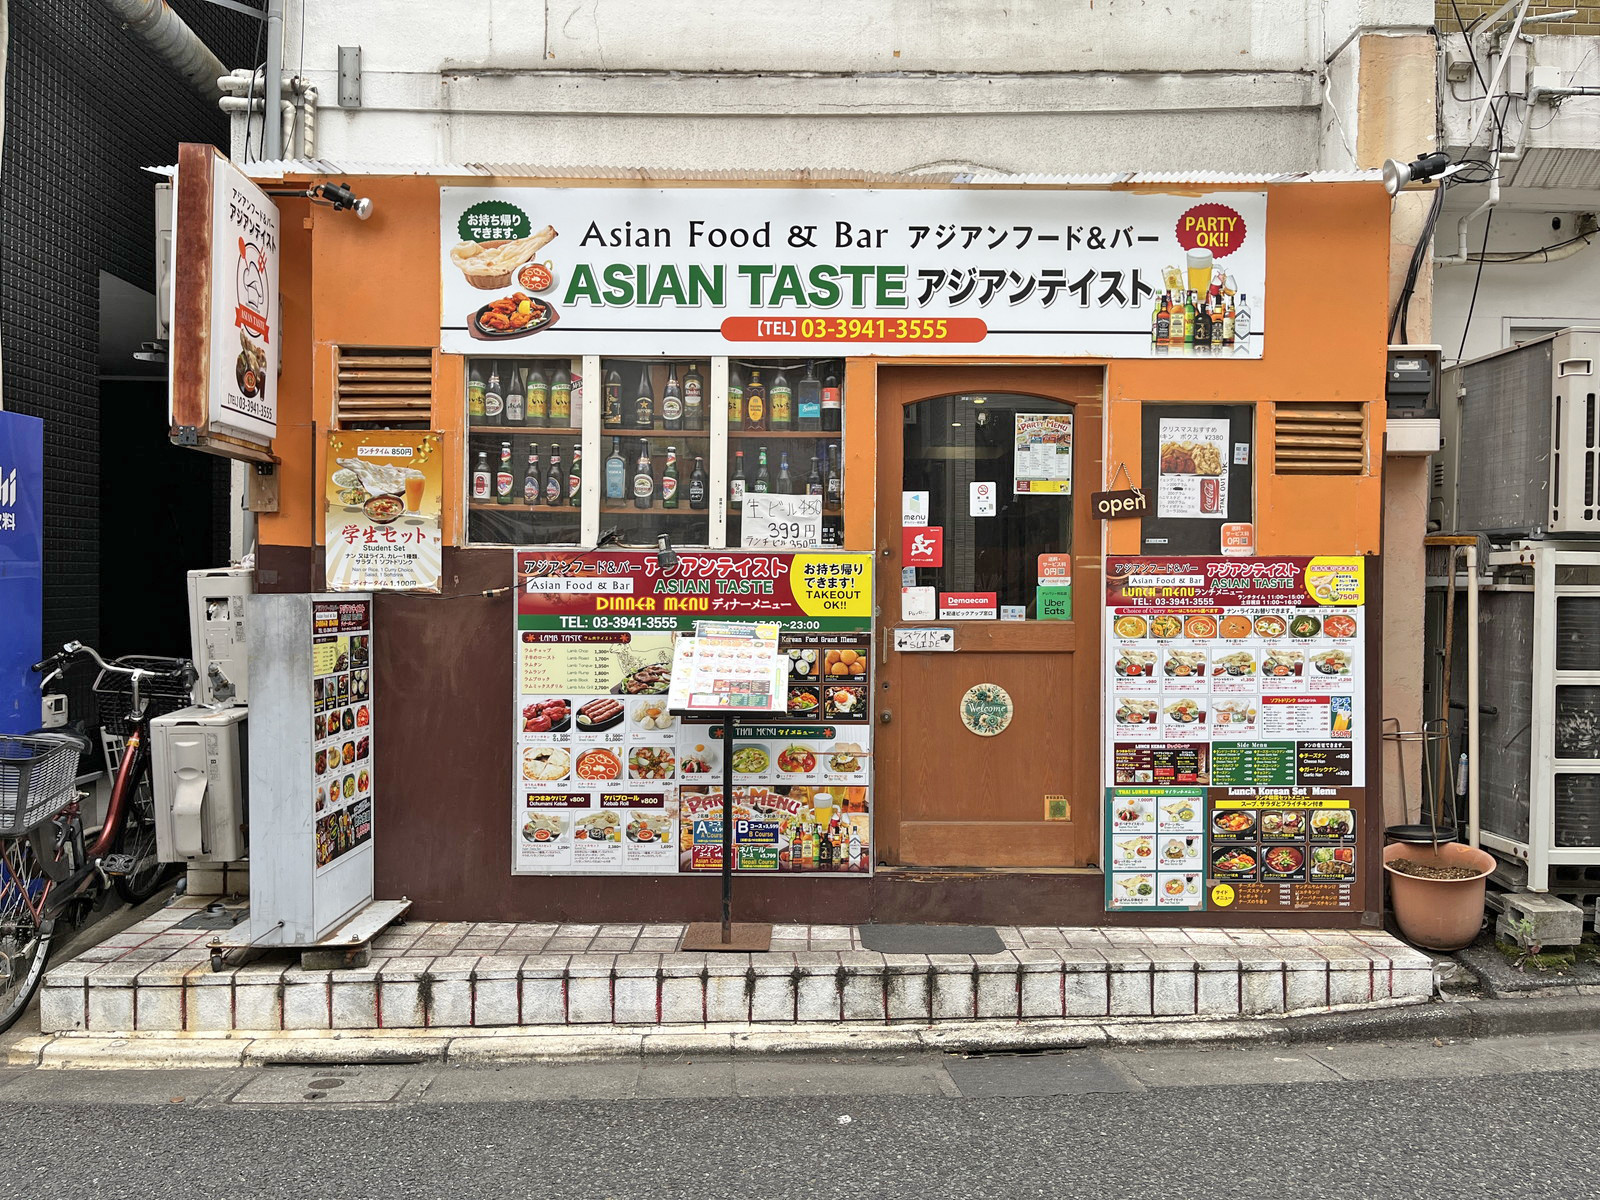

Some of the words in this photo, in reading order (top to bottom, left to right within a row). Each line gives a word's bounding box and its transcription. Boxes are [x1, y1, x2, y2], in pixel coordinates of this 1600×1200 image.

[467, 214, 521, 227] お持ち帰り
[1185, 216, 1238, 232] PARTY
[230, 202, 277, 254] アジアンテイスト
[470, 227, 518, 239] できます。
[579, 220, 671, 248] Asian
[689, 220, 771, 248] Food
[788, 224, 818, 248] &
[836, 221, 888, 249] Bar
[908, 224, 1160, 251] アジアンフード&バー
[1196, 232, 1229, 247] OK!!
[562, 263, 726, 307] ASIAN
[738, 263, 906, 307] TASTE
[916, 268, 1154, 307] アジアンテイスト
[801, 318, 948, 339] 03-3941-3555
[239, 396, 273, 419] 03-3941-3555
[1020, 421, 1043, 431] PARTY
[1047, 421, 1068, 431] MENU
[392, 448, 412, 456] 850円
[1222, 462, 1227, 474] OK
[1098, 496, 1146, 517] open
[342, 525, 426, 544] 学生セット
[768, 522, 816, 540] 399円
[524, 561, 641, 574] アジアンフード&バー
[803, 563, 863, 575] お持ち帰り
[1115, 563, 1198, 573] アジアンフード&バー
[1207, 563, 1300, 577] アジアンテイスト
[531, 581, 561, 589] Asian
[566, 581, 592, 590] Food
[598, 582, 607, 590] &
[612, 582, 630, 590] Bar
[654, 579, 710, 593] ASIAN
[716, 580, 773, 594] TASTE
[804, 577, 855, 589] できます!
[1211, 578, 1250, 588] ASIAN
[1254, 578, 1294, 588] TASTE
[806, 590, 861, 599] TAKEOUT
[1162, 587, 1194, 596] MENU
[596, 597, 656, 611] DINNER
[664, 597, 709, 611] MENU
[712, 598, 792, 610] ディナーメニュー
[823, 601, 847, 609] OK!!
[1044, 599, 1065, 607] Uber
[1132, 598, 1152, 606] TEL:
[1155, 598, 1214, 606] 03-3941-3555
[559, 616, 588, 629] TEL:
[593, 616, 677, 629] 03-3941-3555
[909, 640, 941, 648] SLIDE
[968, 702, 1006, 713] Welcome
[749, 787, 801, 815] MENU
[696, 821, 707, 834] A
[738, 821, 748, 833] B
